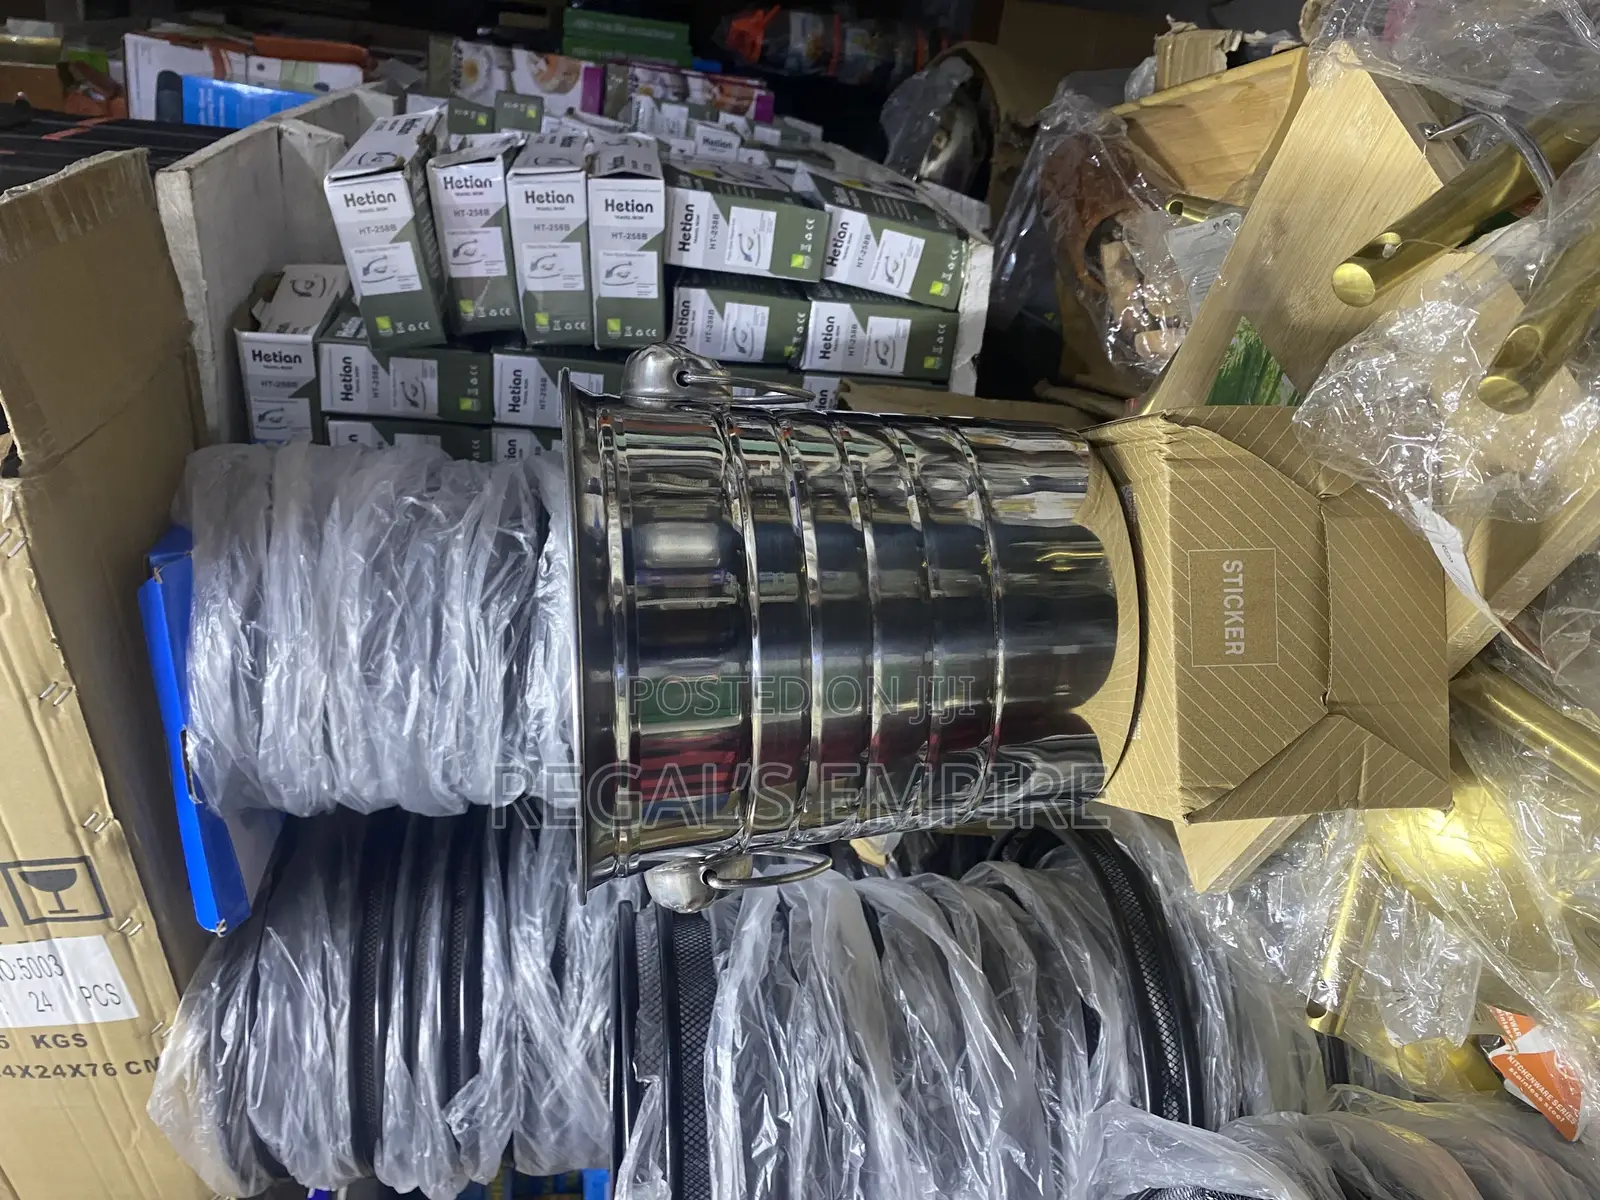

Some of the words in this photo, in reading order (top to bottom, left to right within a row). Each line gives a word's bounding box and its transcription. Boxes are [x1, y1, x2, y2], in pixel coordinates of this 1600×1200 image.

[443, 175, 493, 190] Hetian
[524, 190, 575, 204] Hetian
[343, 190, 397, 208] Hetian
[604, 198, 653, 213] Hetian
[677, 203, 695, 253] Hetian
[709, 213, 720, 250] HT-258B
[826, 221, 849, 267] Hetian
[856, 233, 871, 268] HT-258B
[675, 300, 691, 345] Hetian
[818, 316, 836, 360] Hetian
[251, 349, 302, 364] Hetian
[340, 356, 354, 402] Hetian
[507, 369, 522, 413] Hetian
[814, 389, 829, 411] ian
[504, 439, 517, 460] ian
[1222, 559, 1245, 655] STICKER
[0, 954, 64, 981] O:5003
[28, 991, 54, 1013] 24
[79, 983, 122, 1008] PCS
[31, 1033, 88, 1049] KGS
[0, 1062, 118, 1079] 4X24X76
[1507, 1055, 1553, 1100] KITCHENWARE
[1551, 1099, 1578, 1125] SERIES
[1508, 1067, 1543, 1102] stainless
[1543, 1101, 1565, 1123] steel
